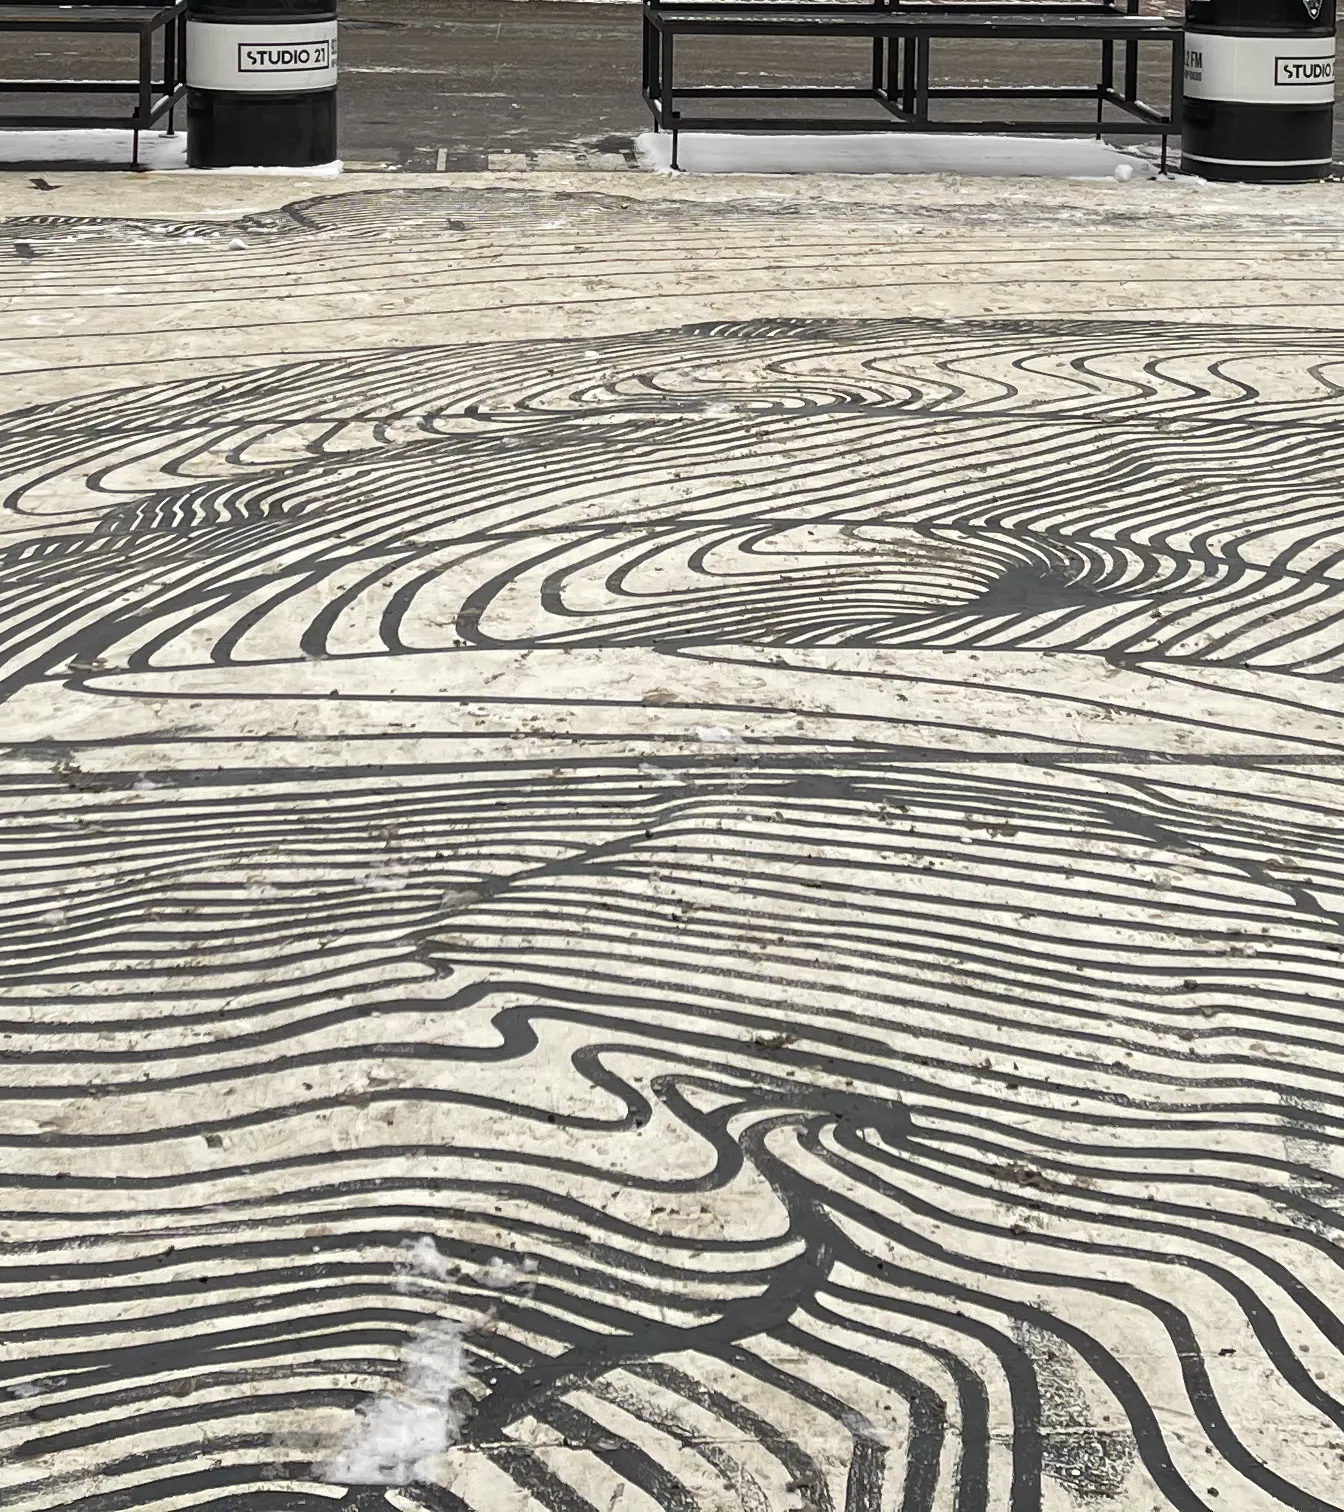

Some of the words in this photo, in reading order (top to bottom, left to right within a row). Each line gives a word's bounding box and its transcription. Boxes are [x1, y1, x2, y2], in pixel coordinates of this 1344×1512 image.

[246, 49, 310, 65] STUDIO
[313, 47, 326, 64] 21
[1283, 62, 1332, 79] STUDIO
